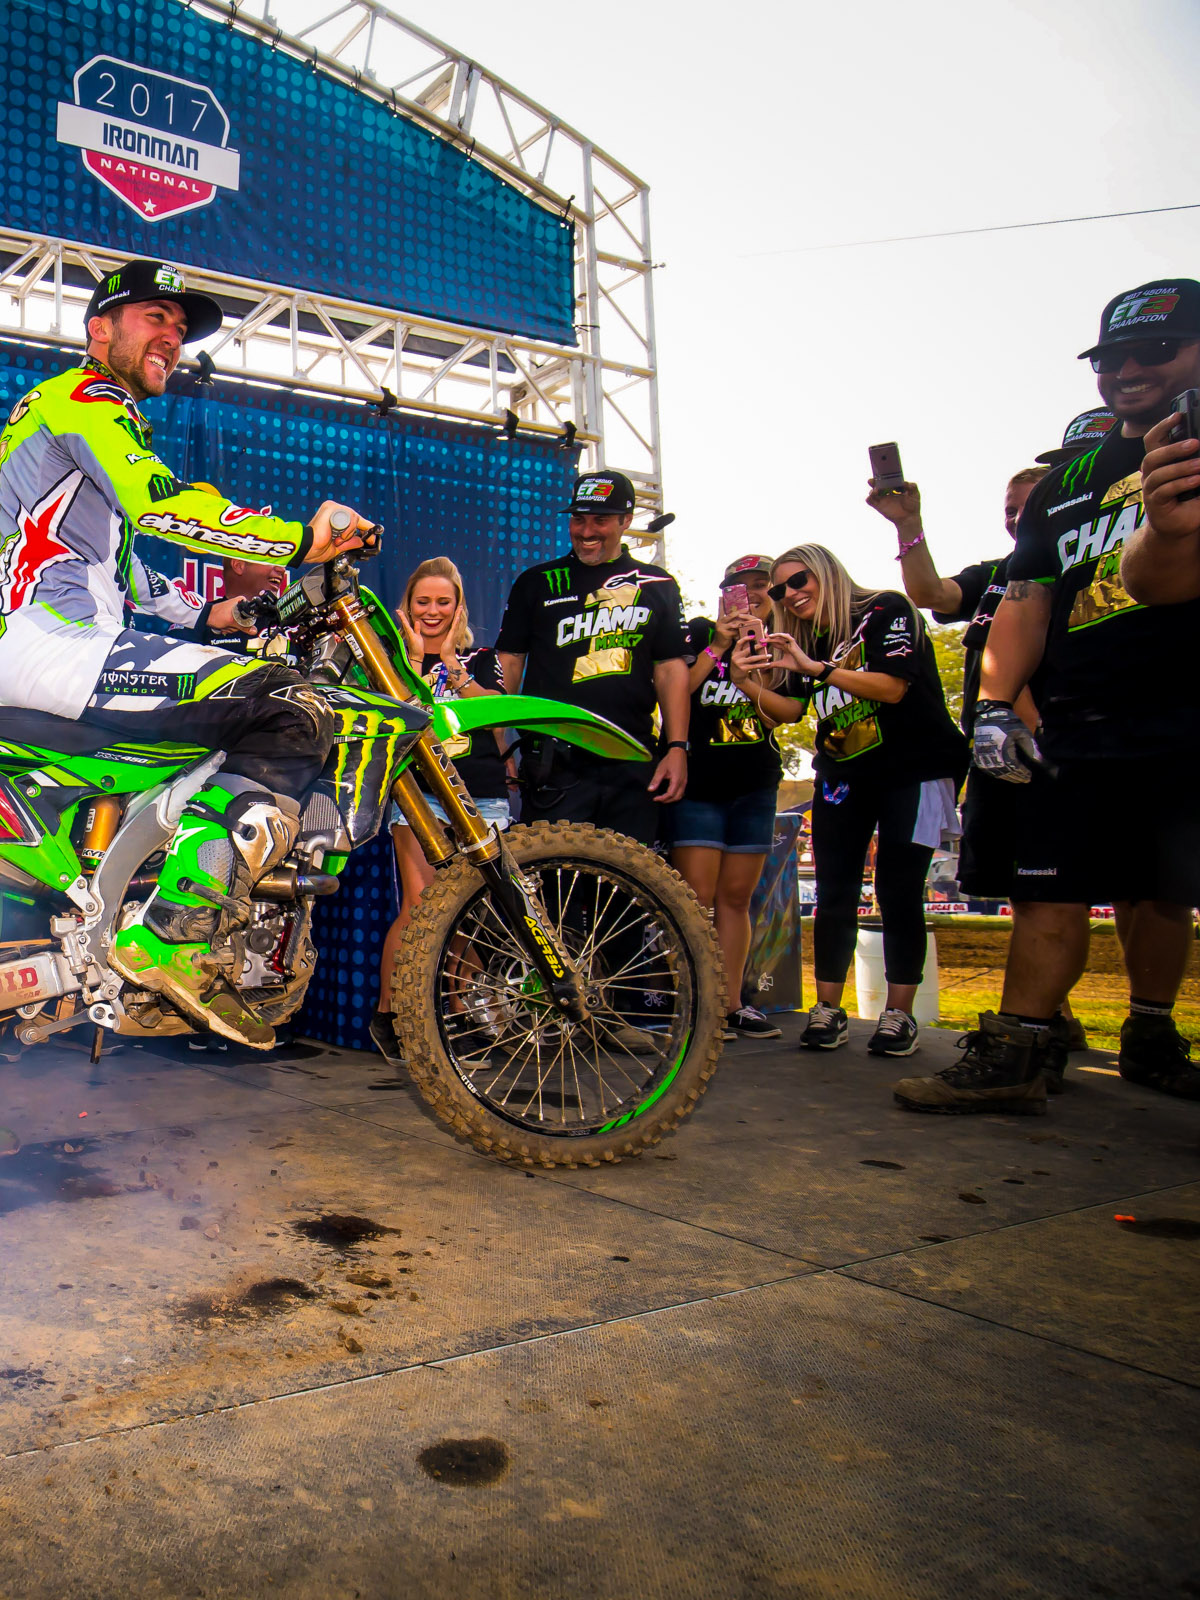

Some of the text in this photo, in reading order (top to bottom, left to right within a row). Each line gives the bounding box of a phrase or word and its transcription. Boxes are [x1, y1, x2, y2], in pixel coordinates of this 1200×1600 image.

[96, 72, 208, 132] 2017
[103, 121, 199, 171] IRONMAN
[100, 157, 200, 193] NATIONAL
[1107, 313, 1168, 332] CHAMPION
[1109, 294, 1181, 325] ET3
[1065, 416, 1119, 439] ET3
[576, 483, 615, 497] ET3
[1046, 491, 1094, 517] Kawasaki
[139, 514, 295, 557] alpinestars
[1056, 503, 1148, 575] CHA
[556, 605, 651, 648] CHAMP
[104, 686, 157, 694] ENERGY
[1016, 866, 1057, 876] Kawasaki
[925, 903, 967, 911] LUCAS OIL
[524, 915, 564, 979] ACERBIS
